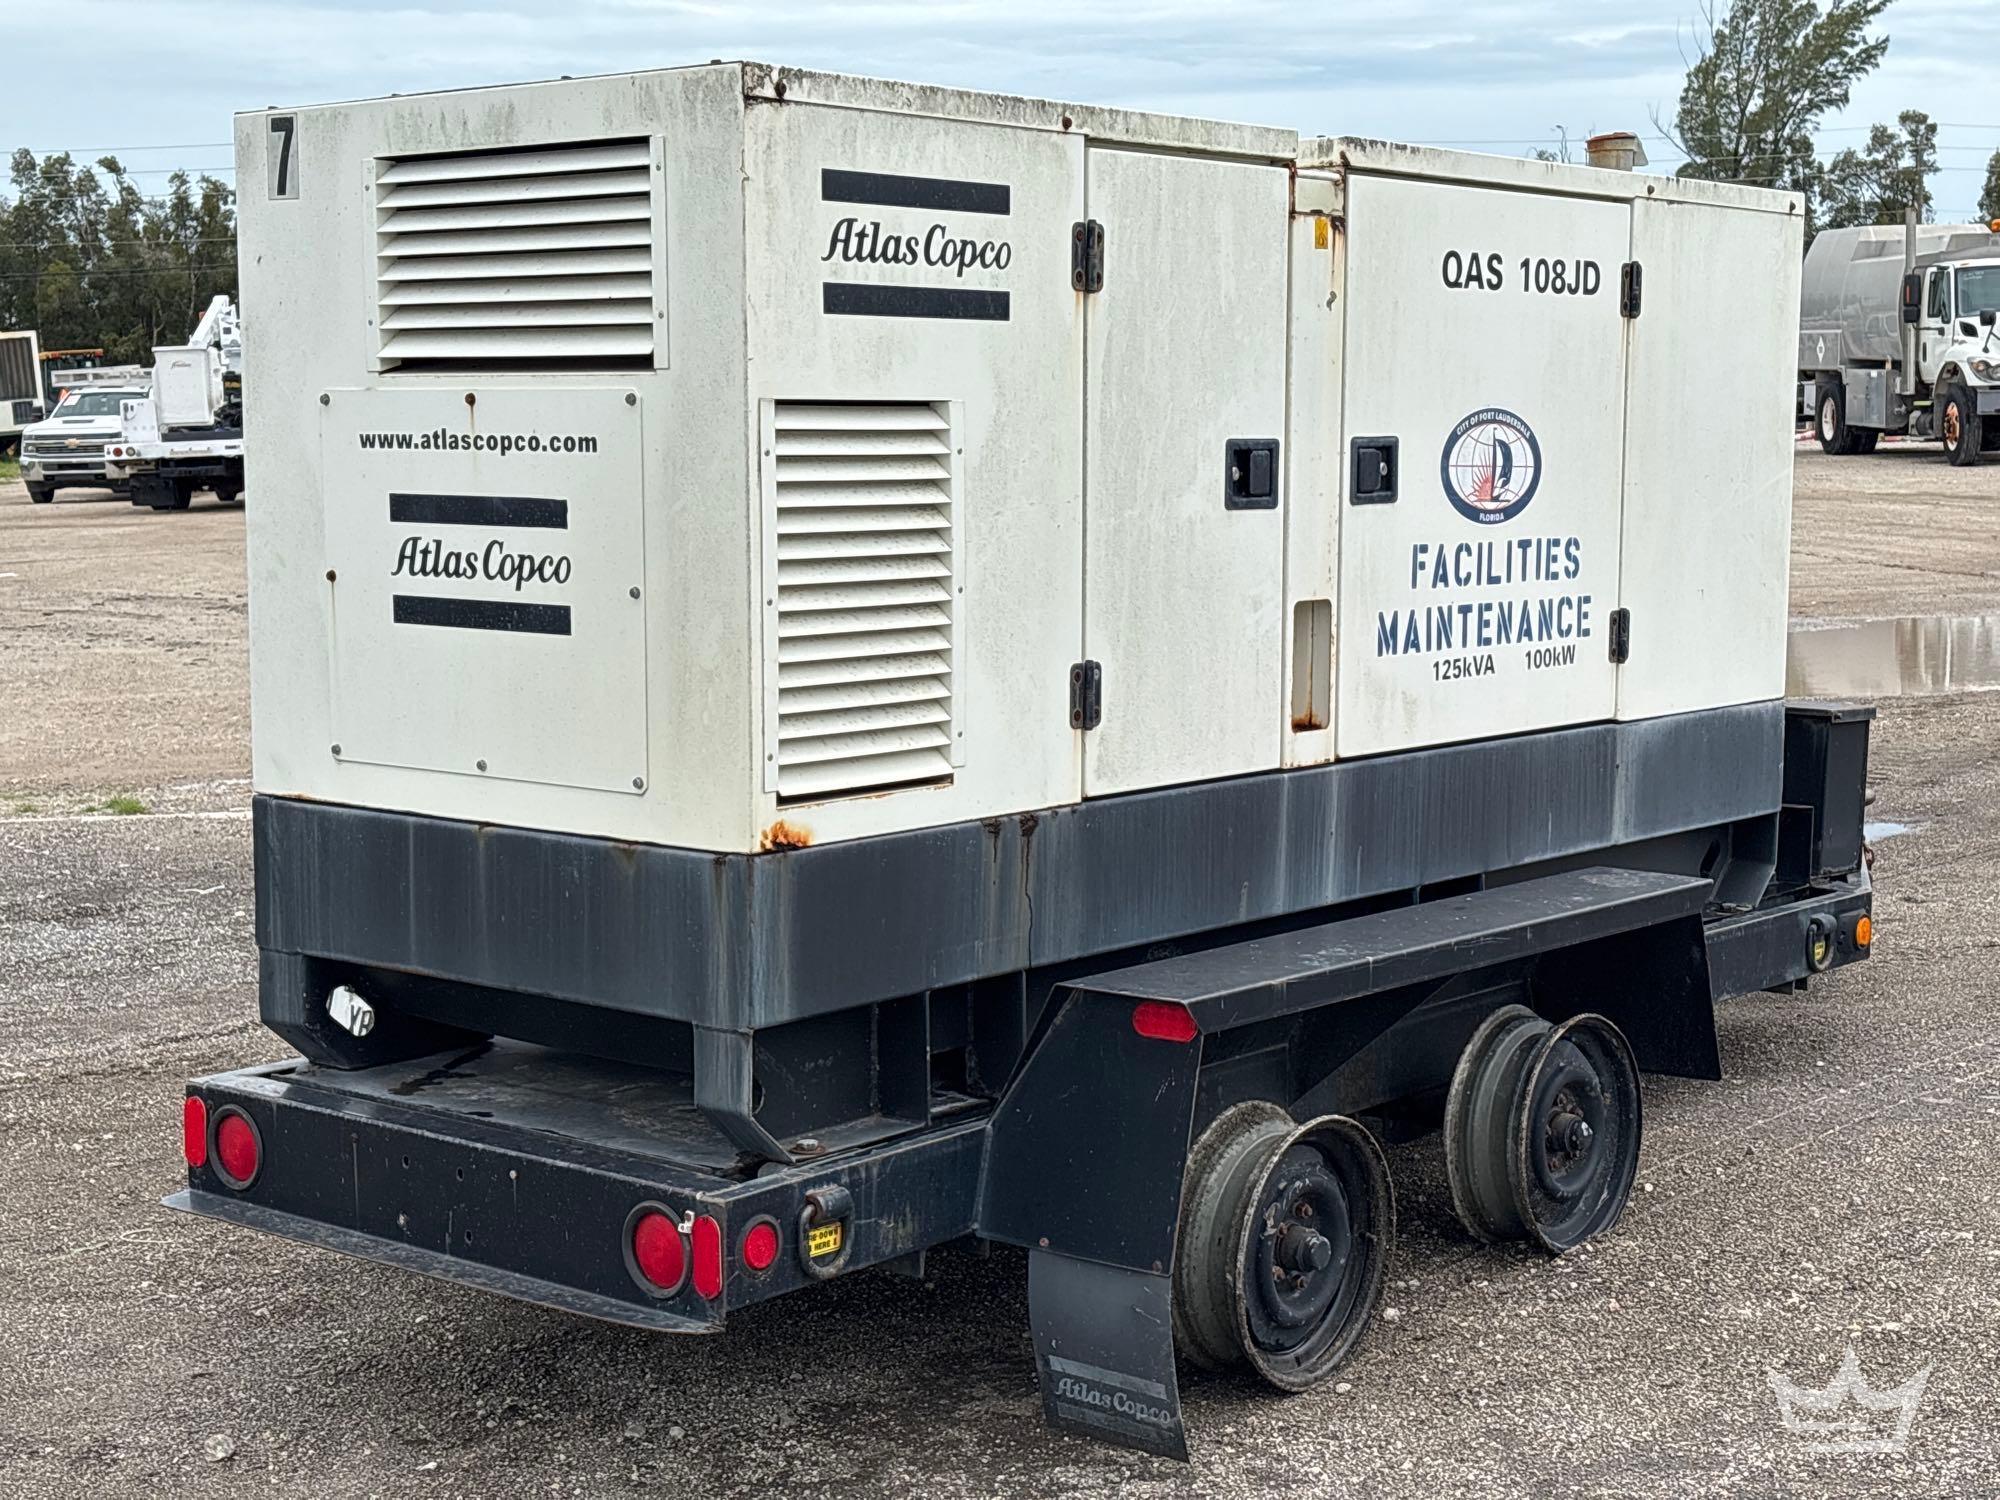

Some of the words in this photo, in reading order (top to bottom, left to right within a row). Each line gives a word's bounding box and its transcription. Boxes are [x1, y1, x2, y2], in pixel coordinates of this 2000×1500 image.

[270, 116, 294, 196] 7
[821, 217, 919, 266] Atlas
[923, 223, 1012, 278] Copco
[1442, 250, 1503, 291] QAS
[1520, 257, 1601, 296] 108JD
[359, 427, 598, 457] www.atlascopco.com
[1456, 420, 1469, 436] CITY
[1470, 414, 1479, 426] OF
[1479, 411, 1495, 421] FORT
[1495, 412, 1531, 439] LAUDERDALE
[1479, 512, 1504, 522] FLORIDA
[391, 536, 478, 580] Atlas
[483, 539, 572, 592] Copco
[1411, 536, 1581, 590] FACILITIES
[1377, 595, 1592, 658] MAINTENANCE
[1433, 654, 1495, 682] 125kVA
[1525, 644, 1576, 670] 100kW
[814, 1240, 831, 1251] HERE
[1055, 1377, 1112, 1408] Atlas
[1113, 1391, 1171, 1425] Copco
